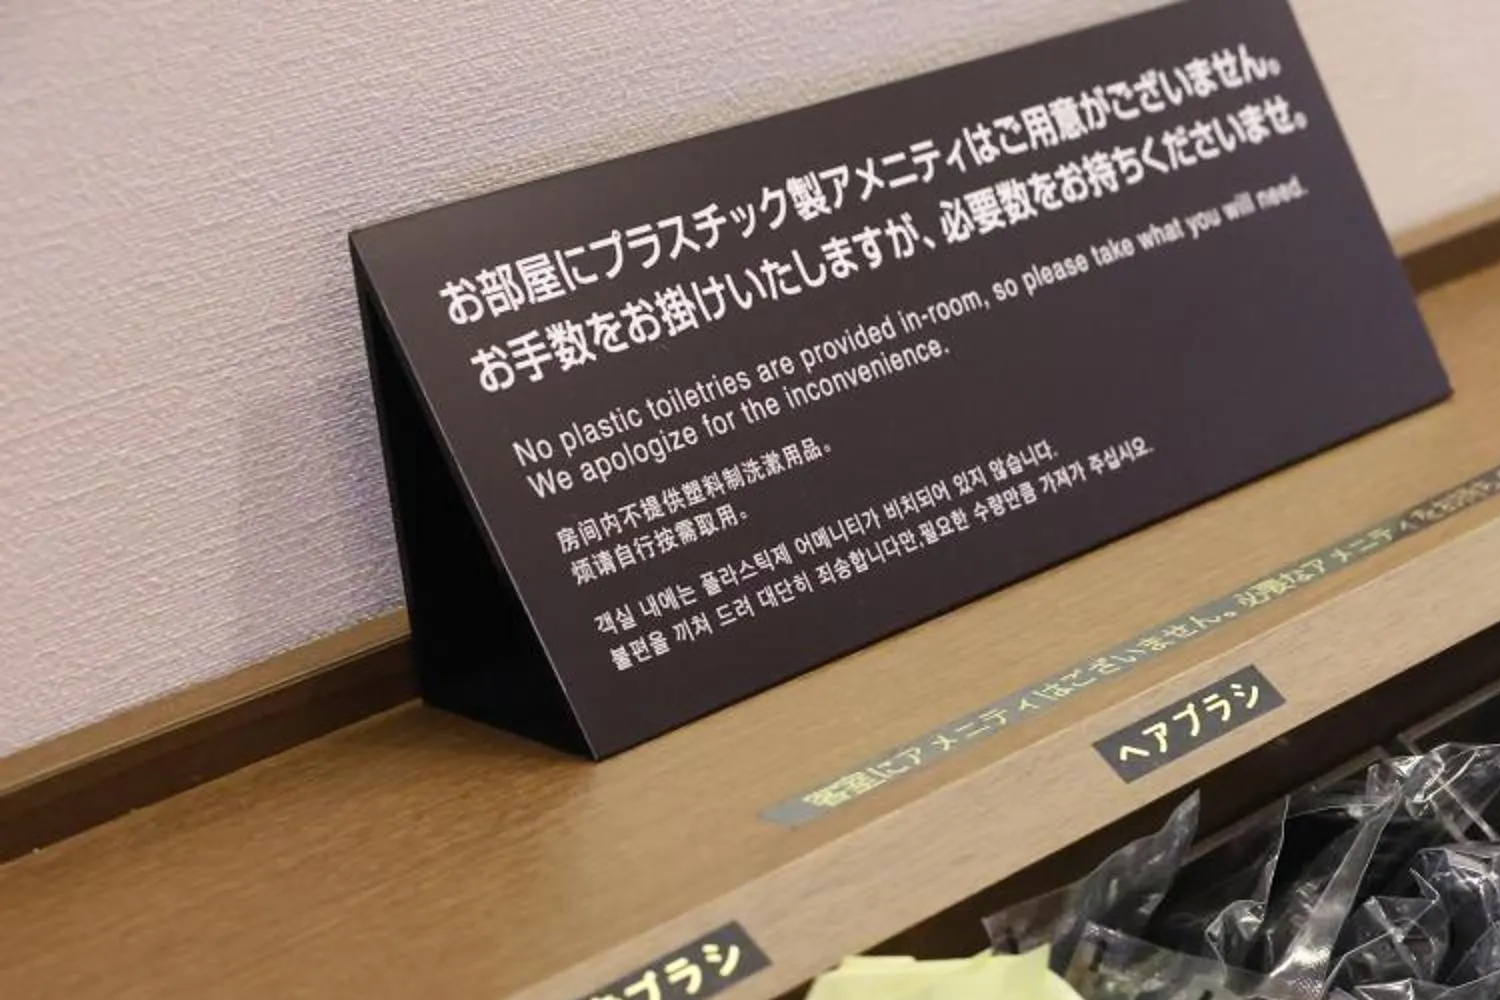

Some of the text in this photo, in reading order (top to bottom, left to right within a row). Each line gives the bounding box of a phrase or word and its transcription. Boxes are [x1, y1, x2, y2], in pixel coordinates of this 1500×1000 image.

[440, 44, 1281, 325] お部屋にプラスチック製アメニティはご用意がございません。
[470, 95, 1308, 392] お手数をお掛けいたしますが、必要数をお持ちくださいませ。
[512, 174, 1309, 467] No plastic toiletries are provided in-room, so please take what you will need.
[526, 338, 950, 498] We apologize for the inconvenience.
[556, 437, 831, 554] 房间内不提供塑料制洗漱用品。
[570, 503, 748, 585] 烦请自行按需取用。
[594, 439, 1059, 635] 객실 내에는 플라스틱제 어메니티가 비치되어 있지 않습니다.
[610, 630, 671, 672] 불편을
[672, 611, 713, 642] 끼쳐
[716, 594, 756, 627] 드려
[757, 571, 814, 608] 대단히
[973, 481, 1037, 522] 수량만큼
[1038, 460, 1087, 493] 가져가
[1087, 436, 1155, 475] 주십시오.
